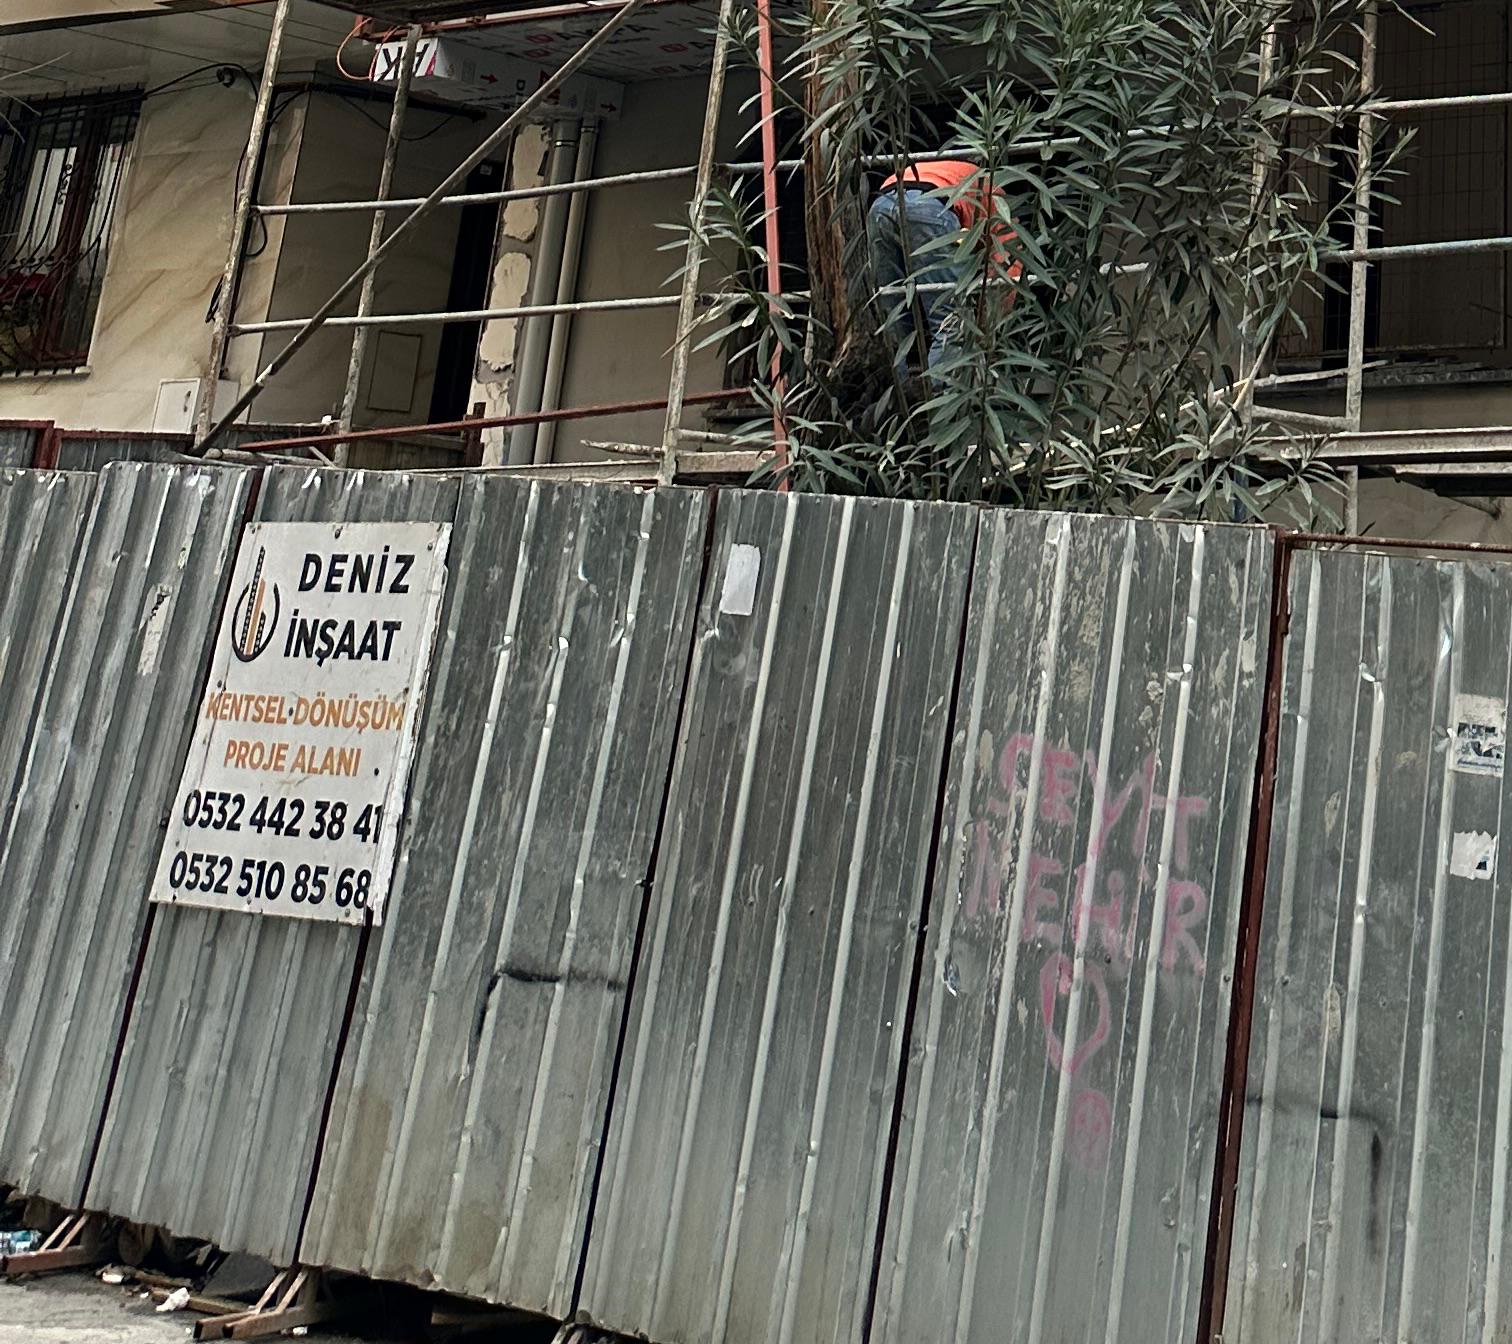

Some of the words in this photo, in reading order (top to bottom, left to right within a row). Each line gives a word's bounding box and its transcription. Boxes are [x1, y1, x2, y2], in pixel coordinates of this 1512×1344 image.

[298, 546, 415, 593] DENİZ
[283, 612, 401, 667] İNŞAAT
[205, 691, 289, 723] KENTSEL
[298, 693, 407, 733] DÖNÜŞÜM
[223, 740, 289, 772] PROJE
[290, 744, 361, 777] ALANI
[184, 789, 245, 832] 0532
[249, 796, 304, 837] 442
[309, 800, 345, 841] 38
[353, 804, 383, 844] 41
[169, 850, 232, 894] 0532
[237, 857, 284, 902] 510
[291, 864, 329, 906] 85
[335, 868, 371, 910] 68
